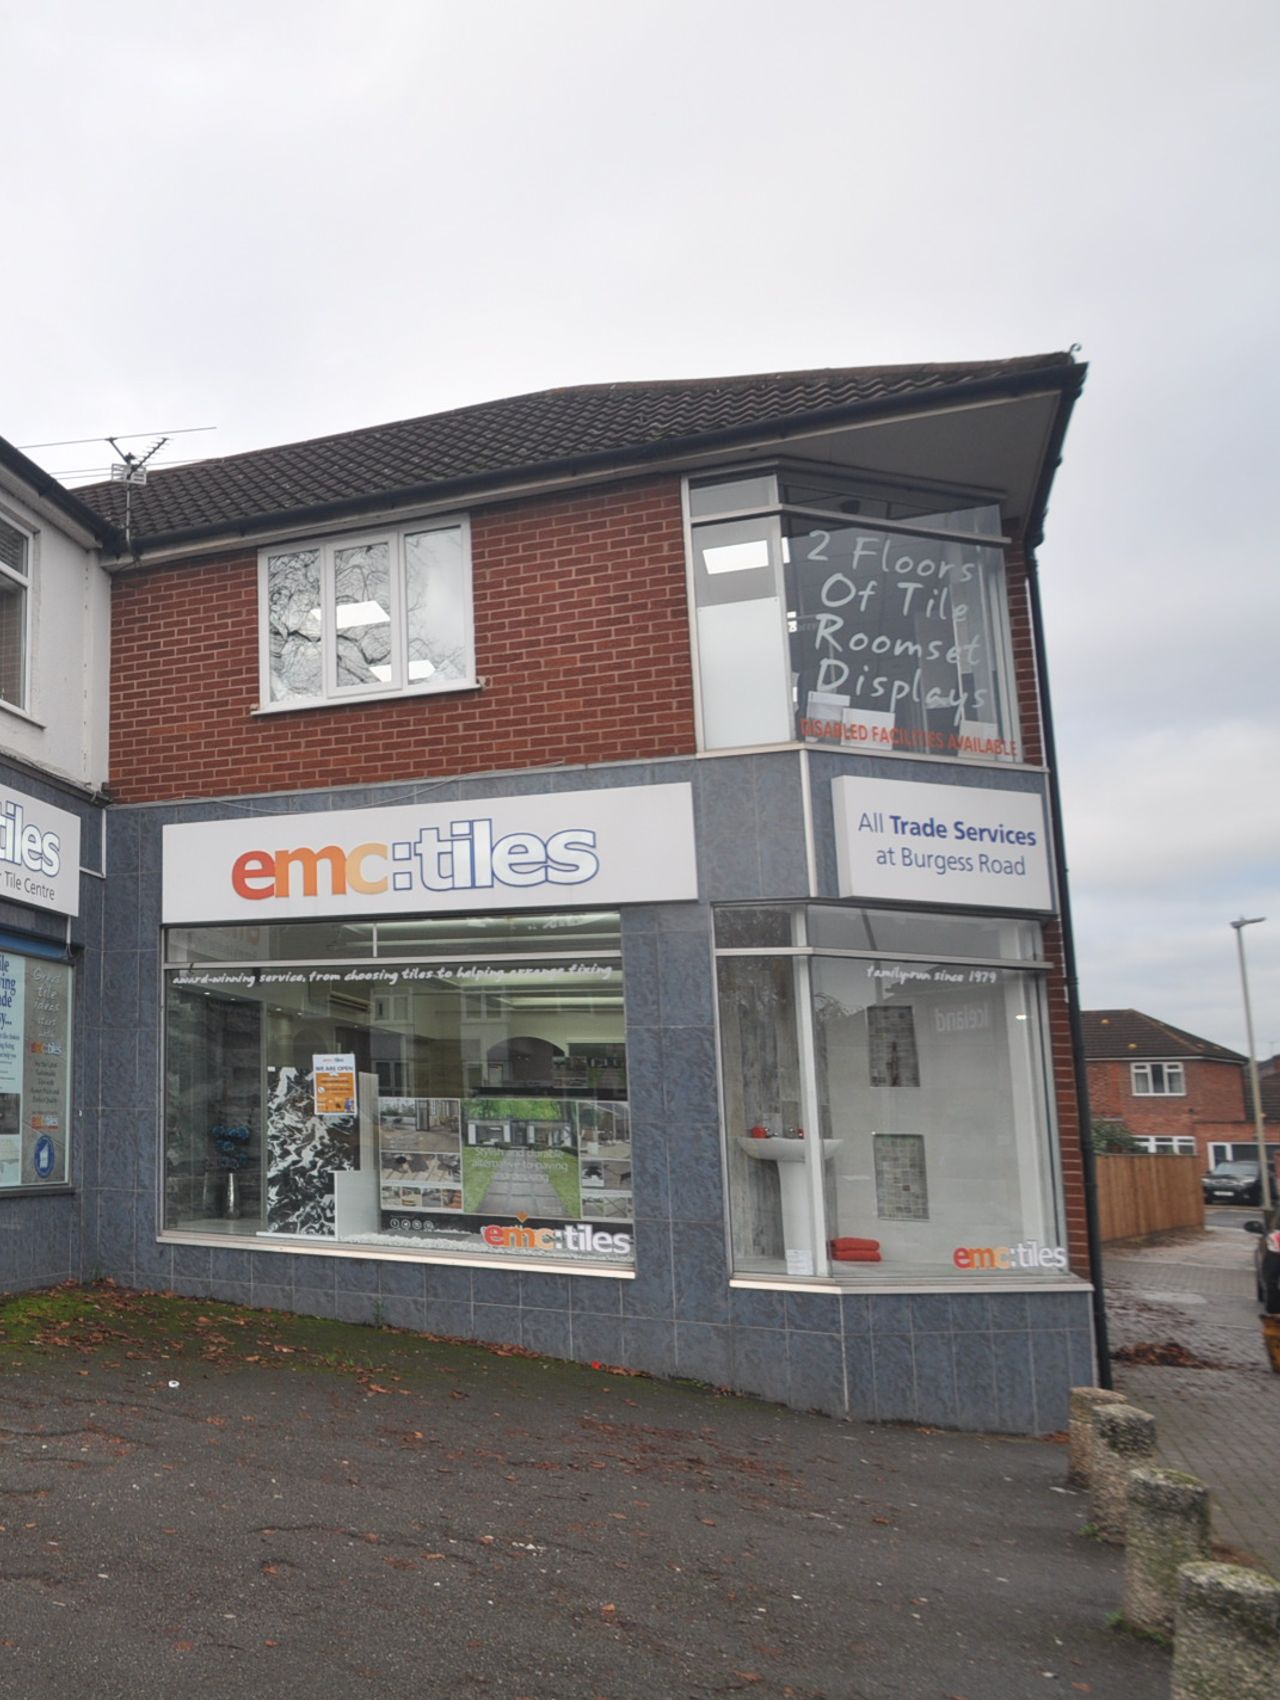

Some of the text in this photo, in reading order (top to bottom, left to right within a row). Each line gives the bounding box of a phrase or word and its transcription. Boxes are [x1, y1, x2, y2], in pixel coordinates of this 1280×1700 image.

[807, 530, 975, 582] 2 Floors
[821, 572, 969, 622] Of Tile
[815, 613, 981, 665] Roomset
[817, 658, 988, 727] Displays
[800, 717, 1018, 757] DISABLED FACILITIES AVAILABLE
[858, 812, 1037, 847] All Trade Services
[231, 817, 600, 901] emc:tiles
[876, 847, 1026, 876] at Burgess Road
[4, 870, 21, 890] Tile
[24, 878, 55, 901] Centre
[172, 963, 613, 988] award-winning service, from choosing tiles to helping arrange fixing
[933, 969, 964, 983] since
[968, 970, 997, 984] 1979
[481, 1222, 632, 1255] emc:tiles
[952, 1240, 1068, 1270] emc:tiles
